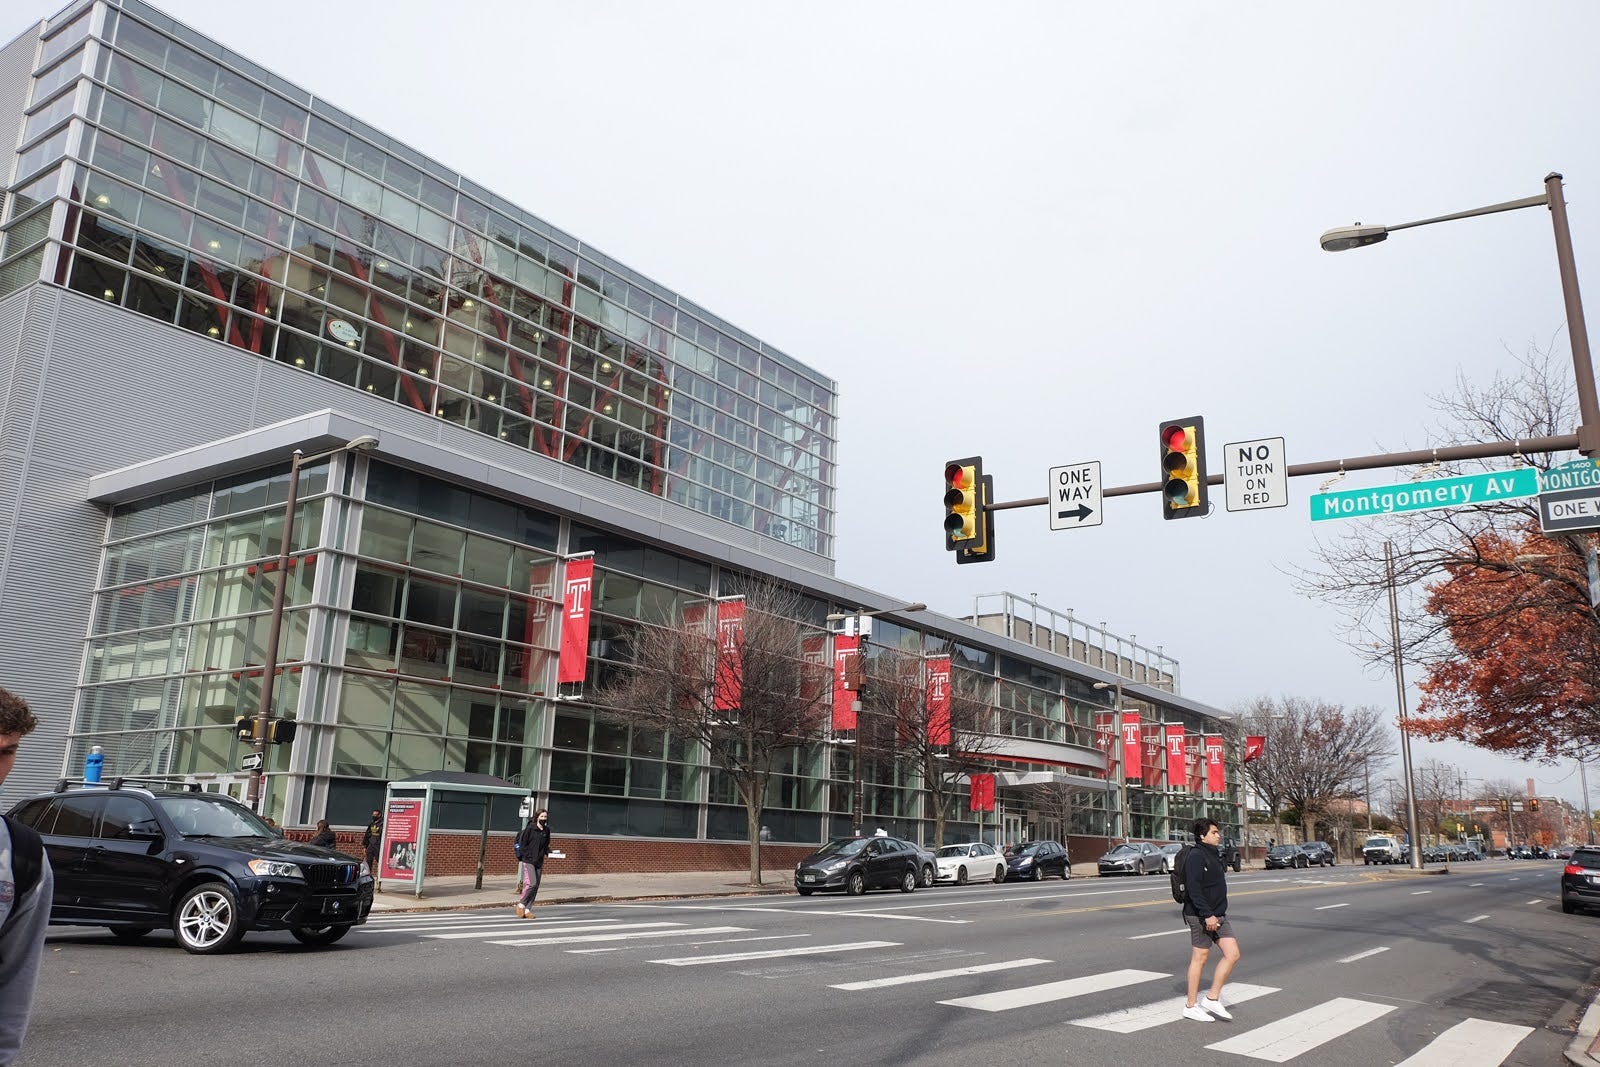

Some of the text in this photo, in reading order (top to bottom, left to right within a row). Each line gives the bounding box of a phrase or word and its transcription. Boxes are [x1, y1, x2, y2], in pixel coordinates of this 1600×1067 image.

[1239, 446, 1270, 463] NO
[1059, 468, 1091, 486] ONE
[1238, 463, 1274, 477] TURN
[1246, 479, 1267, 490] ON
[1059, 485, 1093, 502] WAY
[1243, 492, 1270, 505] RED
[1325, 477, 1516, 515] Montgomery Av
[1553, 502, 1588, 516] ONE
